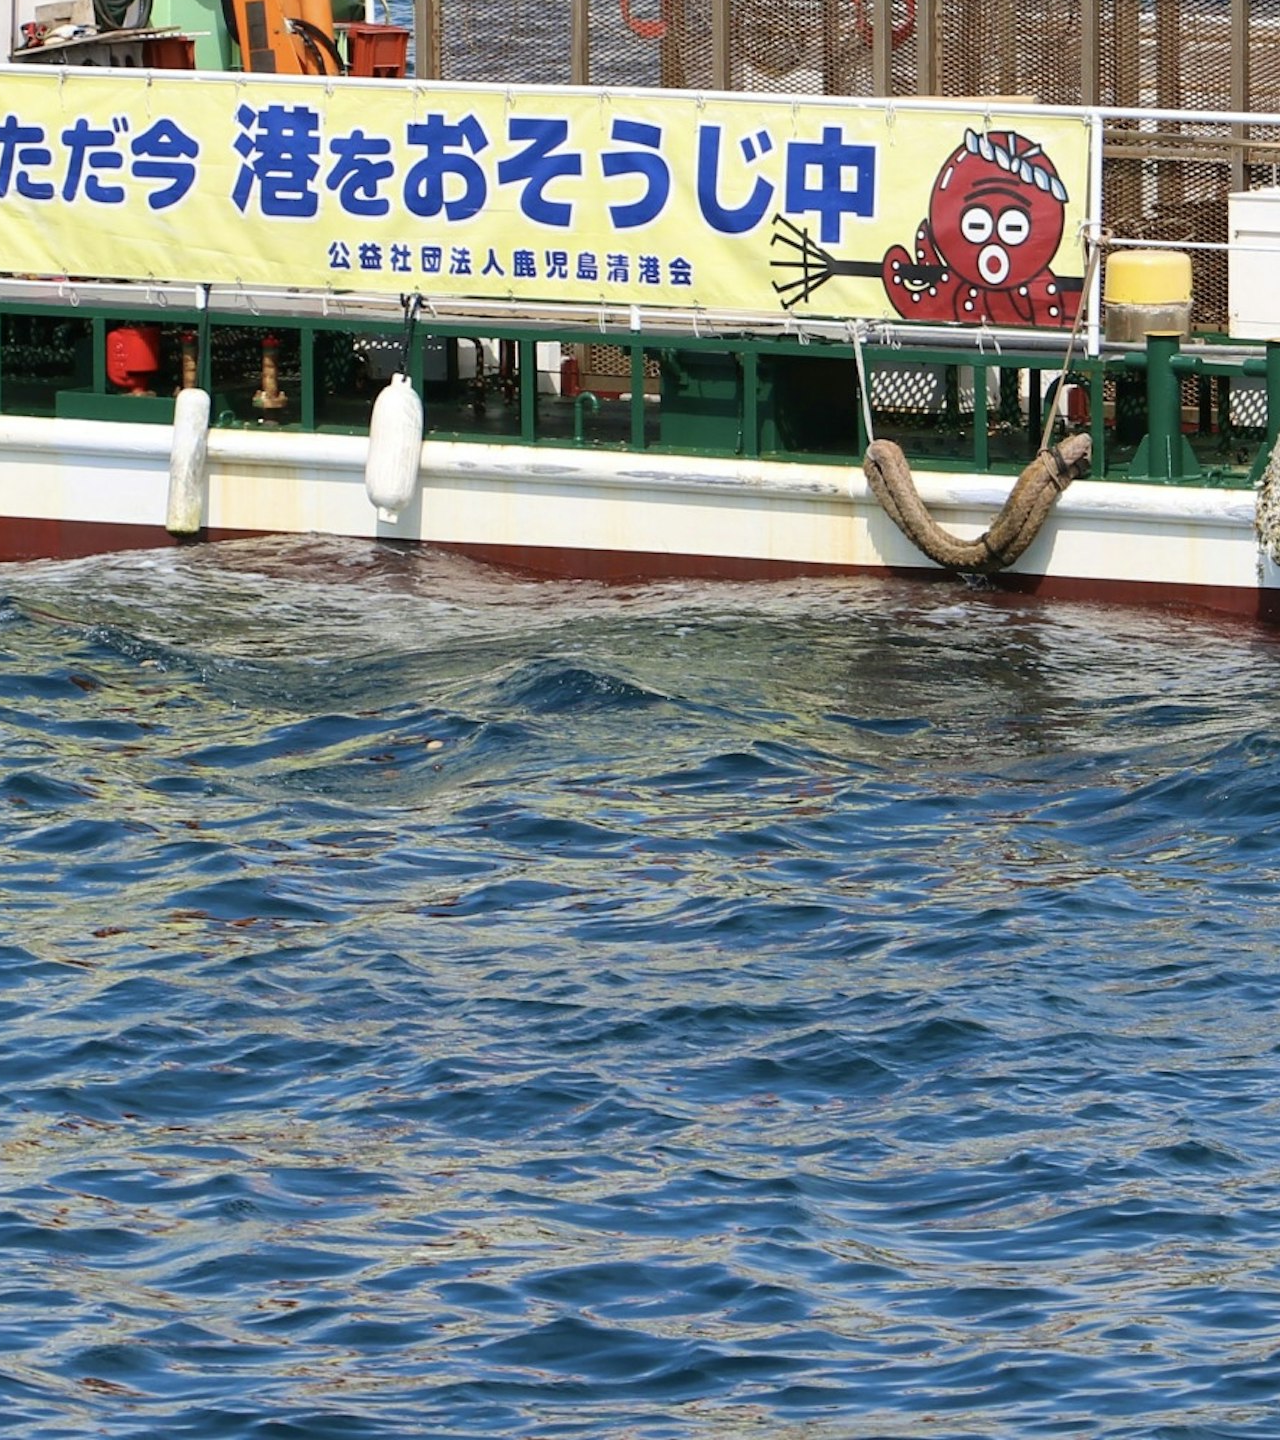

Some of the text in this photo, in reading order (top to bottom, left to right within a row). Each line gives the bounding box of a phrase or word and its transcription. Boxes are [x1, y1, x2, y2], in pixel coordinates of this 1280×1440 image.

[231, 103, 877, 244] 港をおそうじ中
[326, 240, 694, 288] 公益社団法人鹿児島清港会
